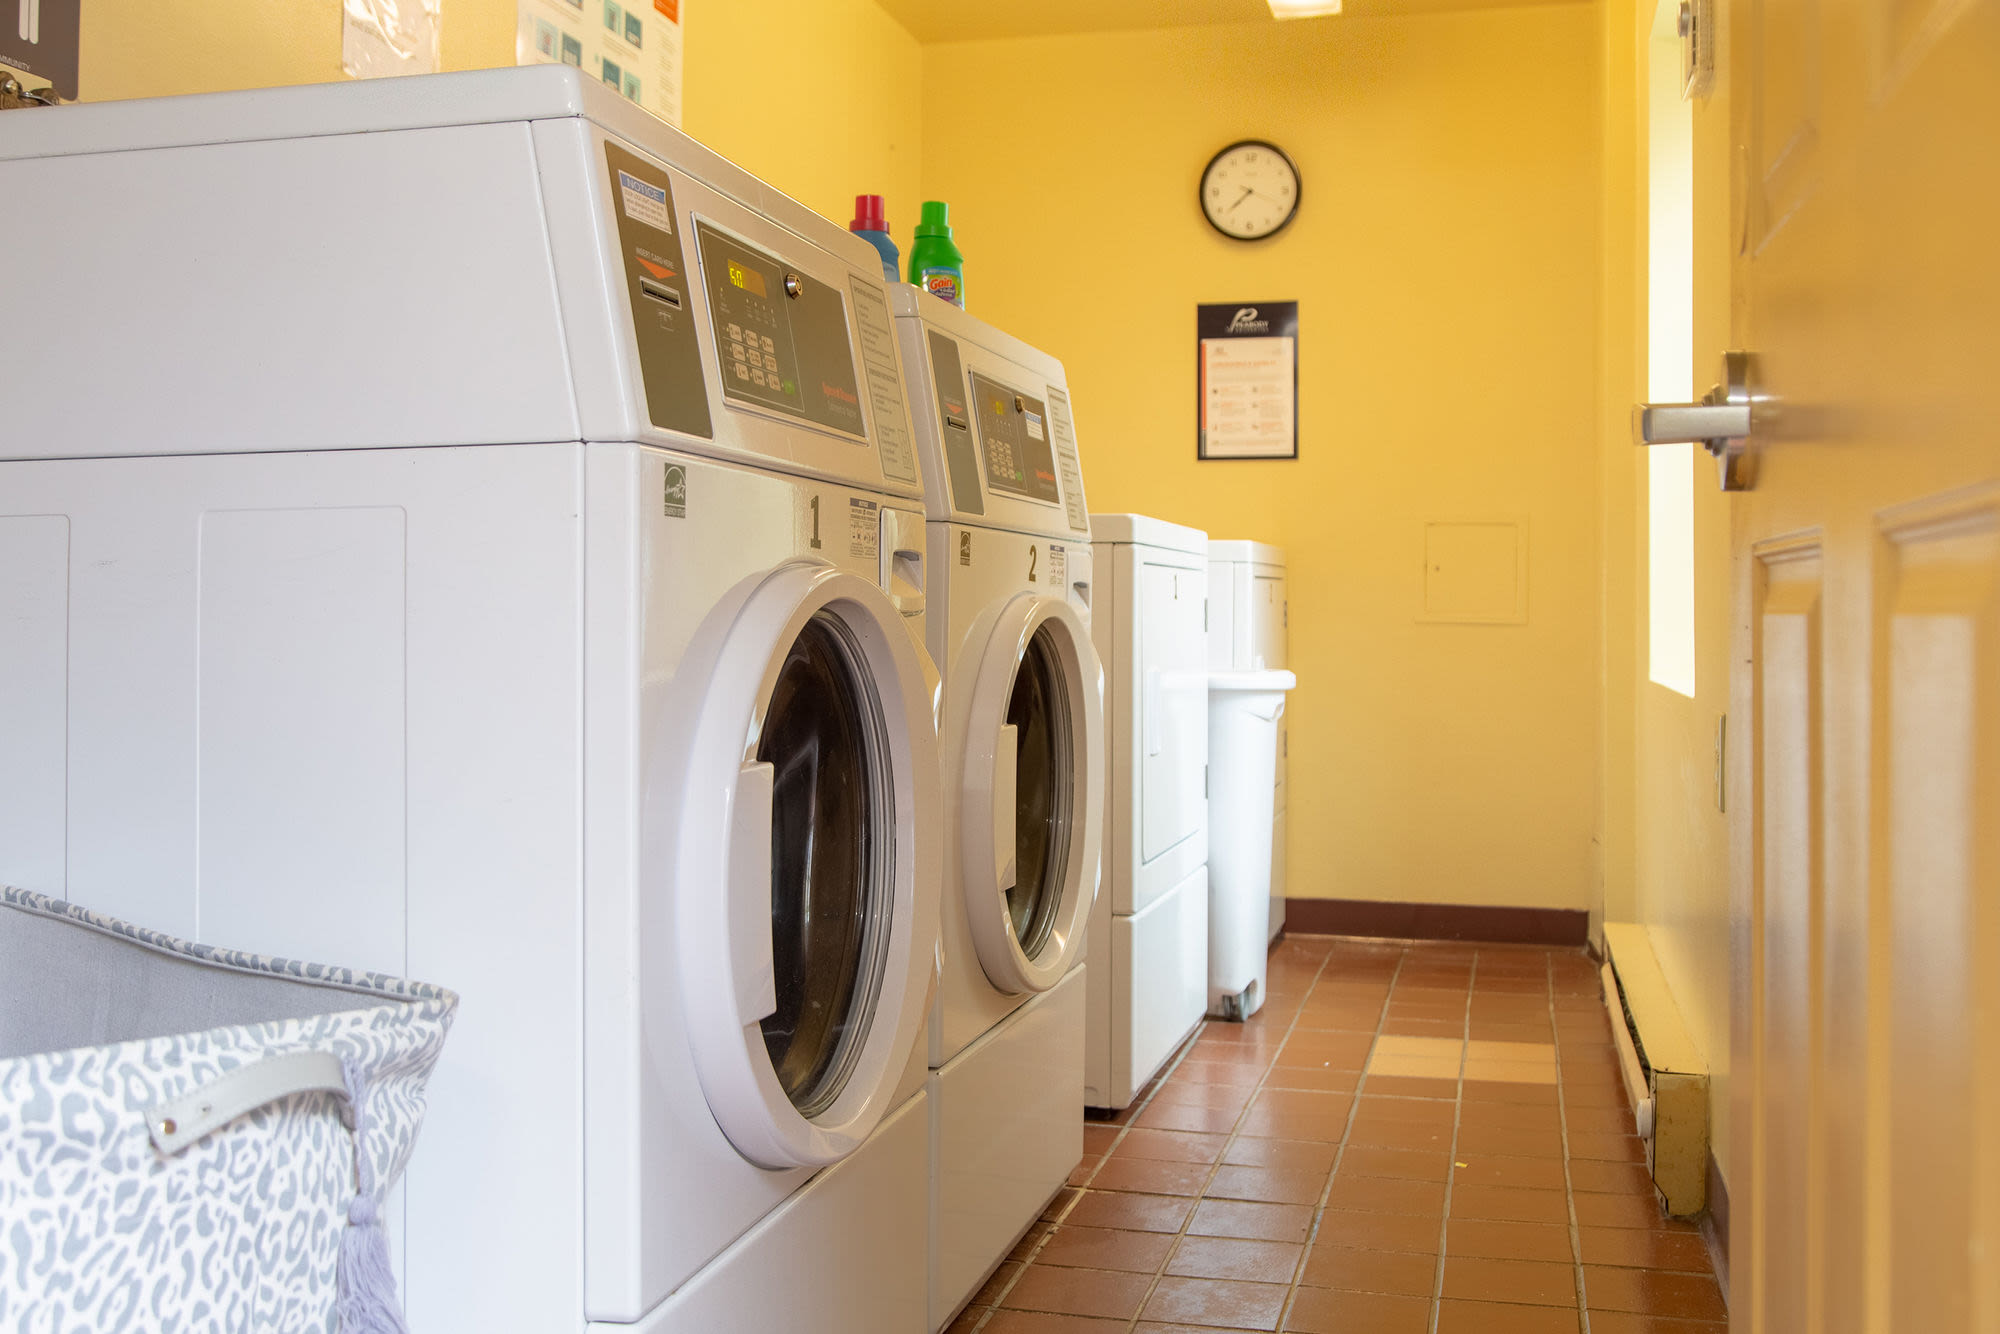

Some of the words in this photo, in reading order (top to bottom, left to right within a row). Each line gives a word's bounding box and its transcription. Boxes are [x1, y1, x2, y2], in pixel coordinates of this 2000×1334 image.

[1245, 152, 1258, 163] 12
[626, 177, 660, 200] NOTICE
[635, 247, 650, 258] INSERT
[929, 278, 953, 290] Gain
[810, 495, 821, 549] 1
[1029, 544, 1037, 582] 2
